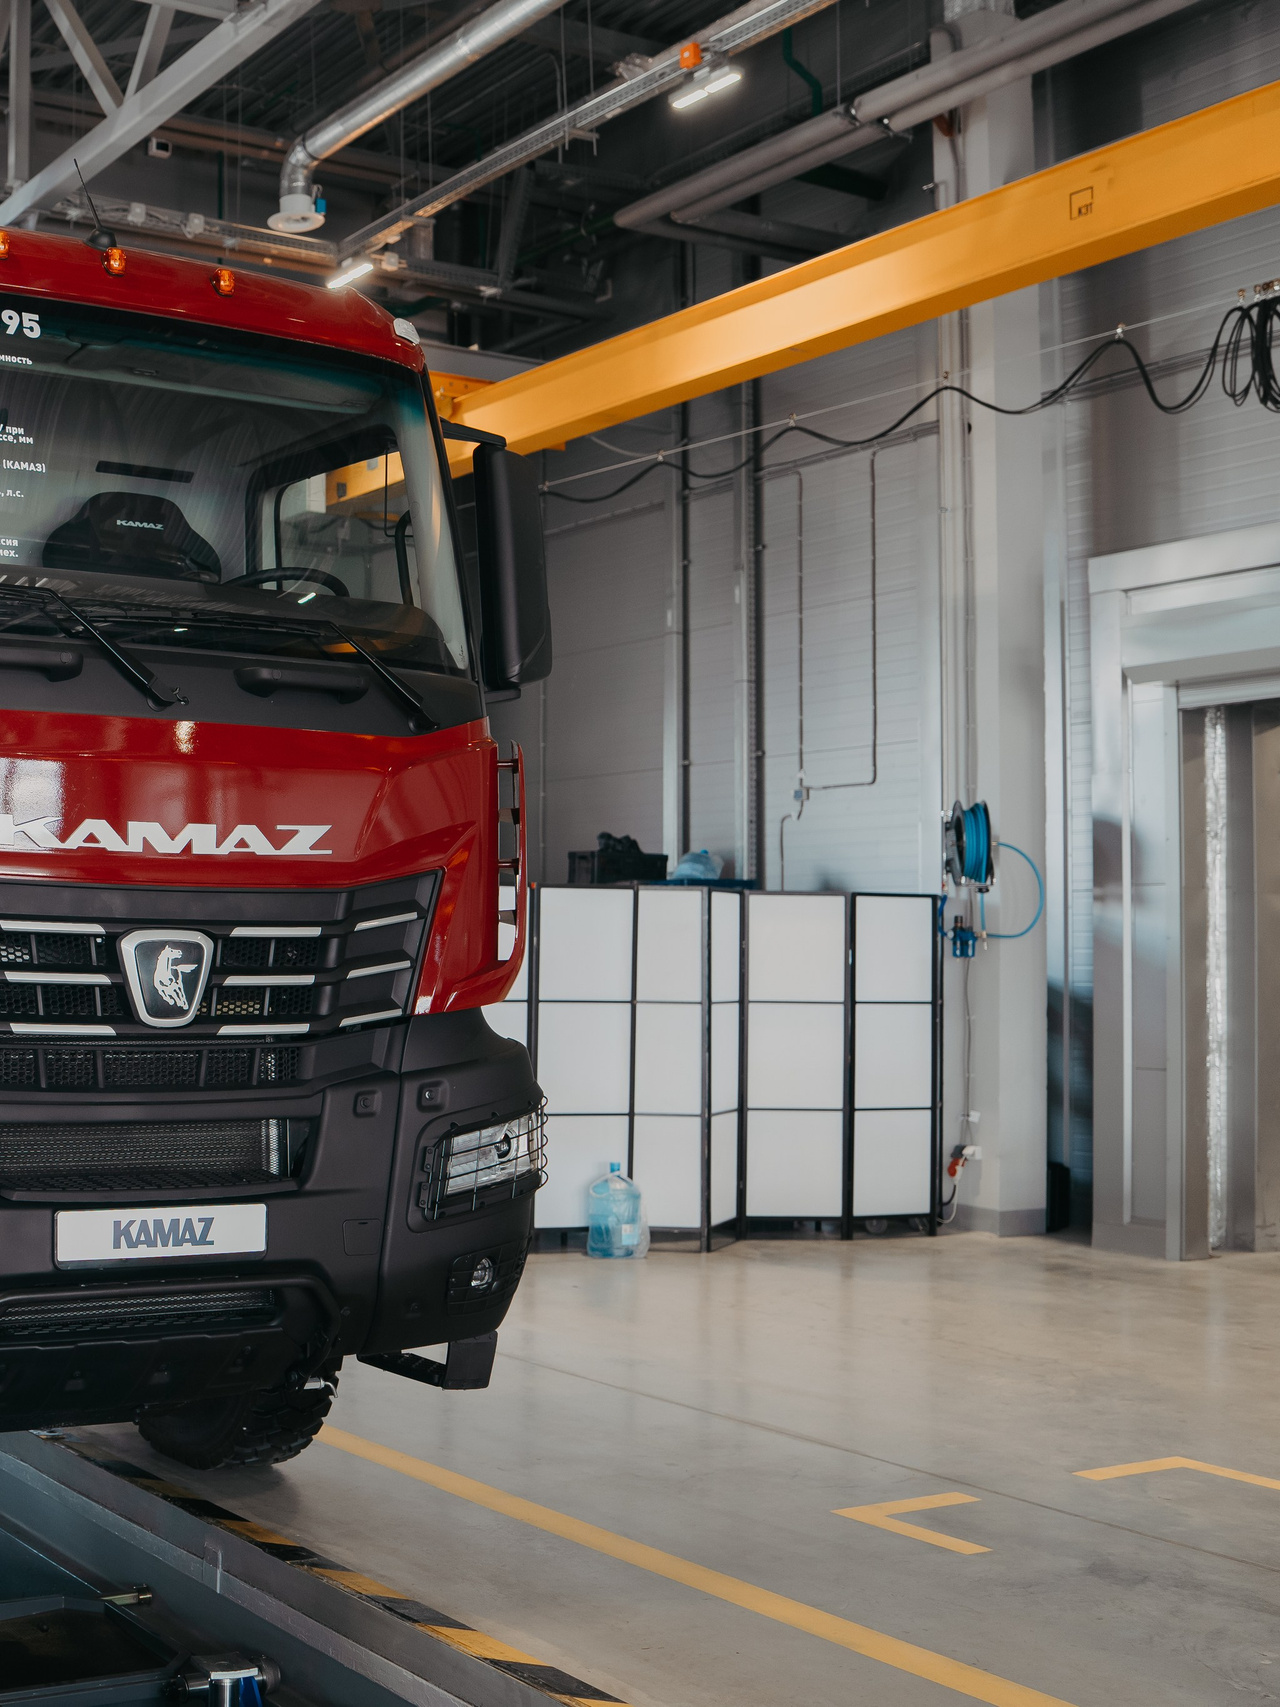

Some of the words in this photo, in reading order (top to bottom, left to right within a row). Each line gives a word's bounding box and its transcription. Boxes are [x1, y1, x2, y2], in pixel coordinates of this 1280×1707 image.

[5, 426, 24, 436] при
[18, 433, 33, 444] мм
[3, 459, 45, 472] (КАМАЗ)
[116, 519, 164, 530] KAMAZ
[113, 1217, 214, 1249] KAMAZ
